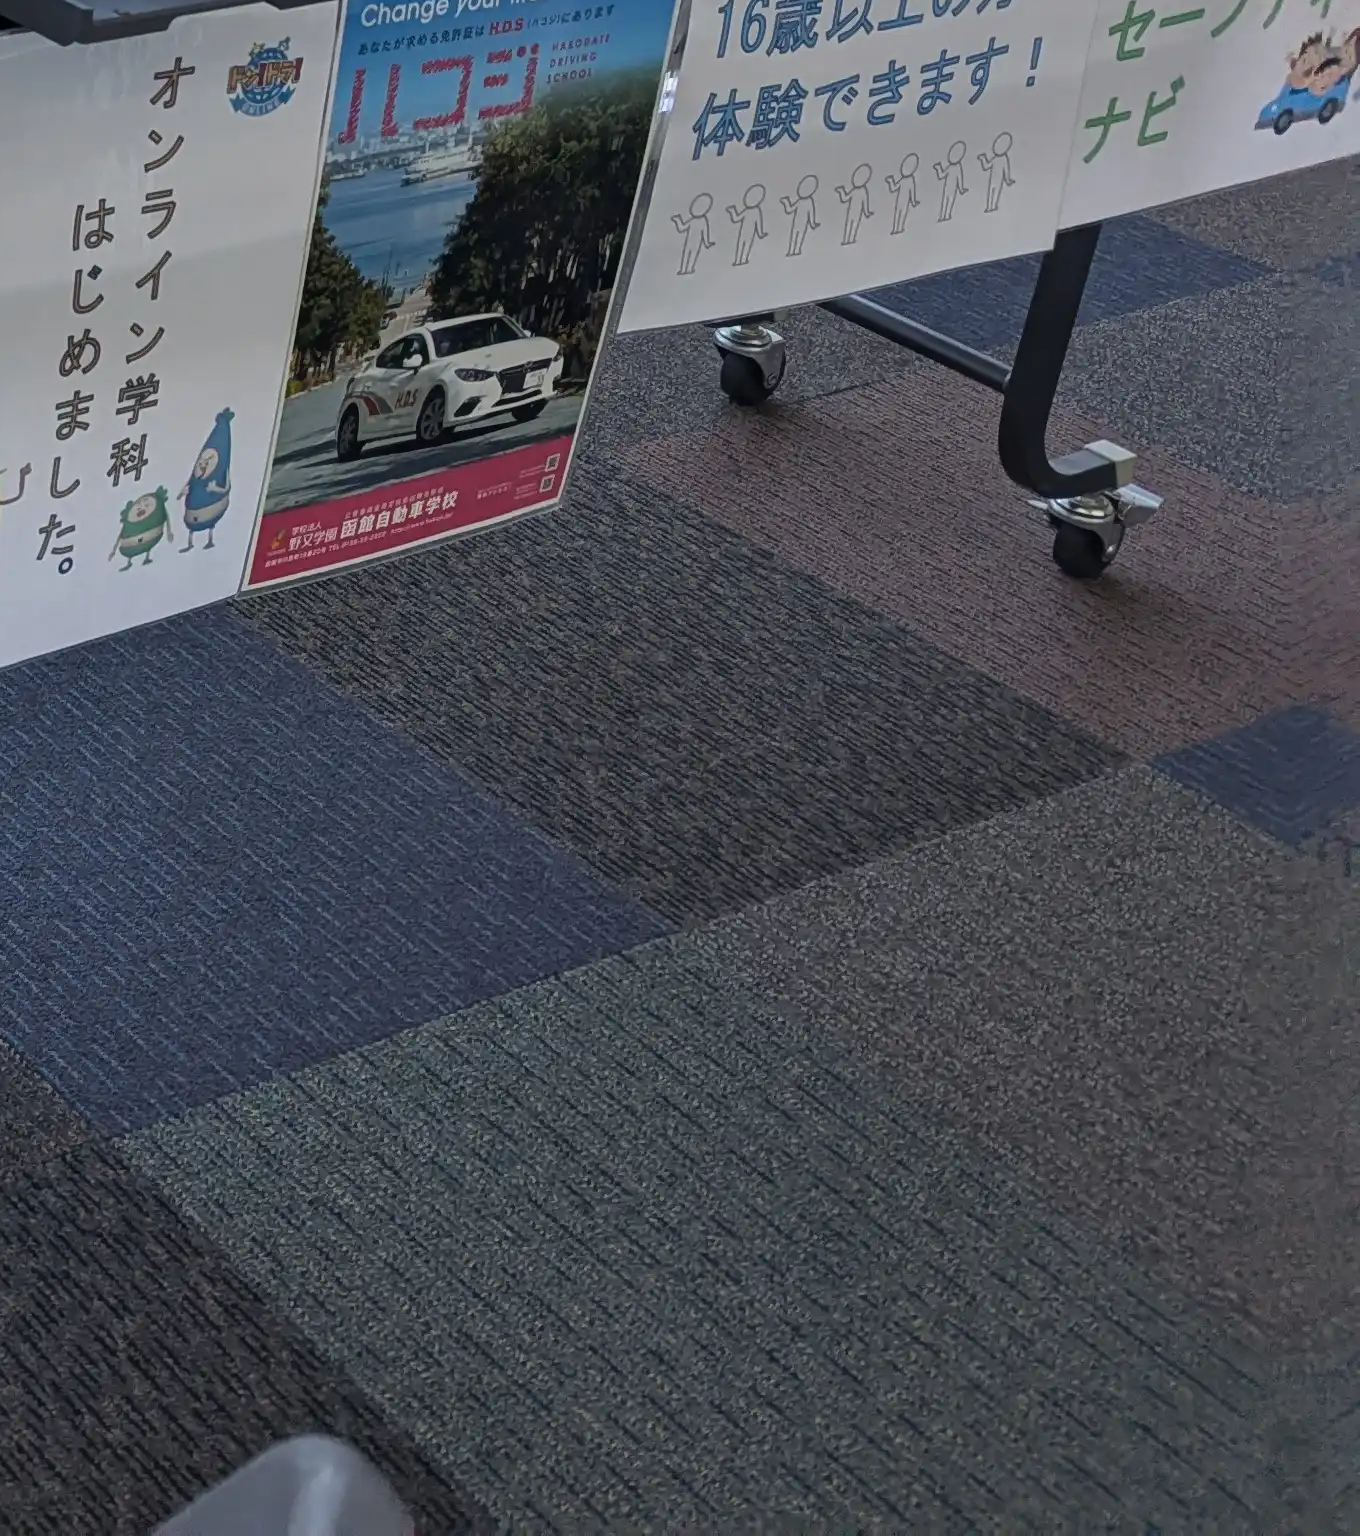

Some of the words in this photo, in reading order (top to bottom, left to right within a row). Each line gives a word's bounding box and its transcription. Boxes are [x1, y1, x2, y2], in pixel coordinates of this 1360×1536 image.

[1081, 76, 1187, 165] ナビ
[106, 55, 196, 488] オンライン学科
[340, 490, 459, 540] 函館自動車学校
